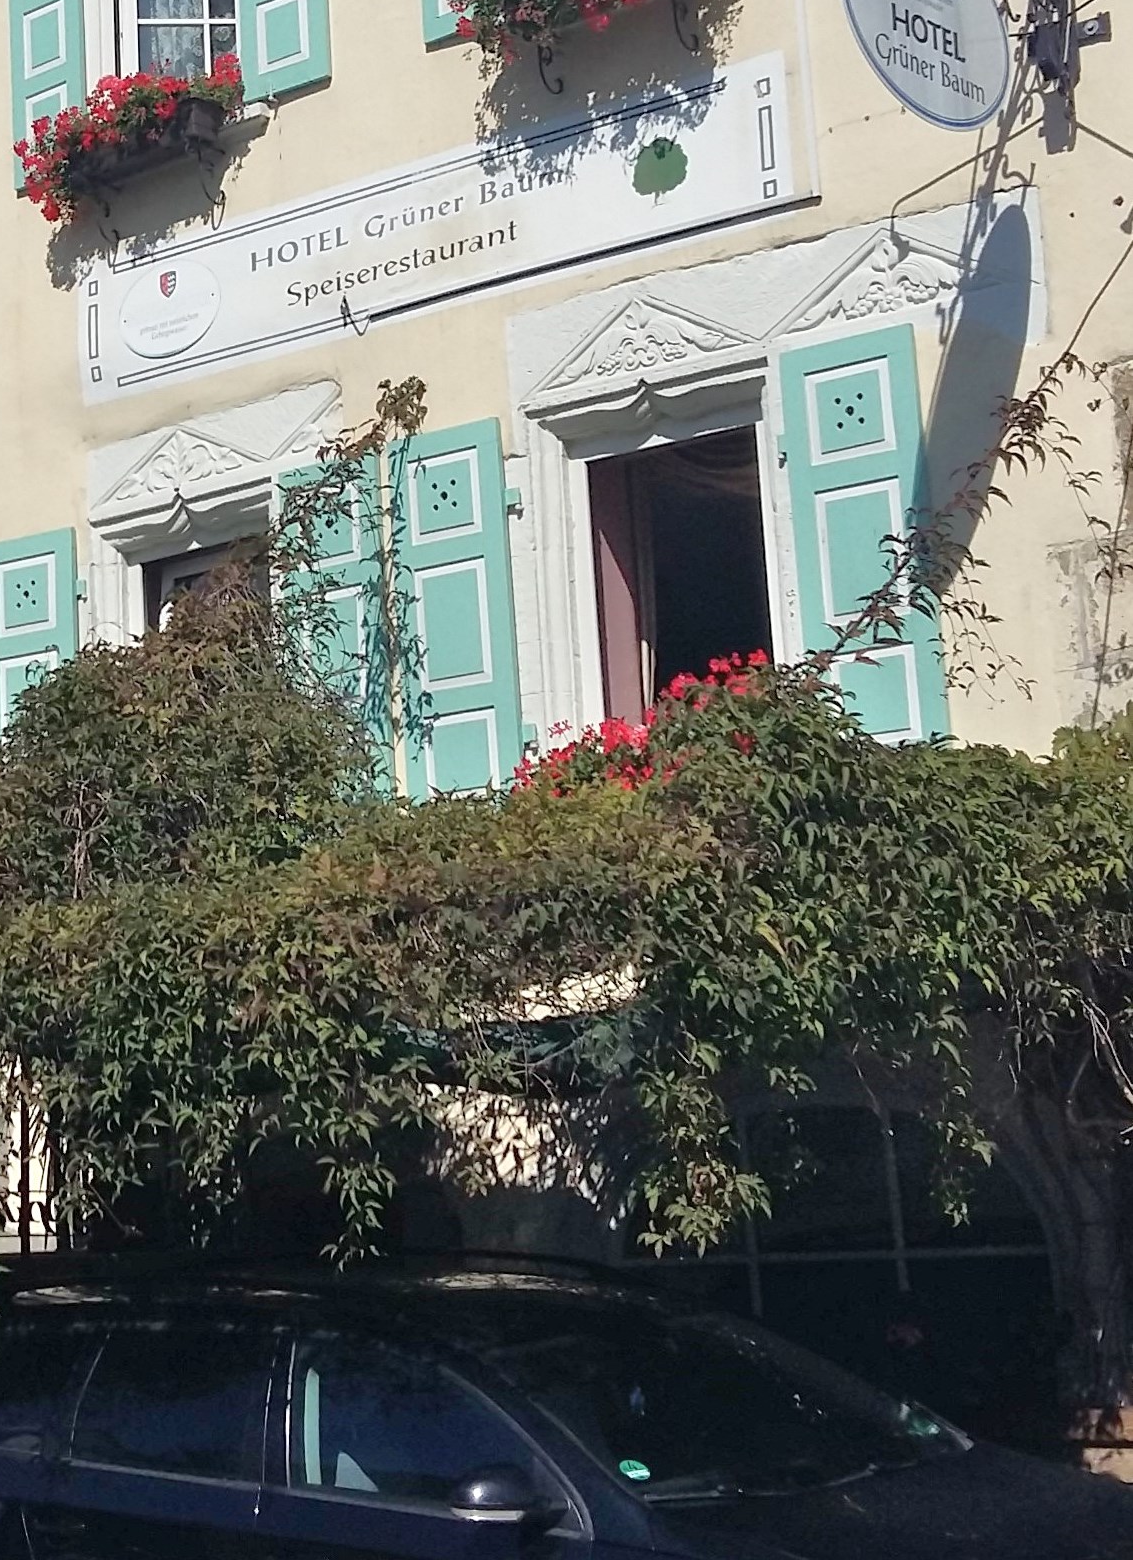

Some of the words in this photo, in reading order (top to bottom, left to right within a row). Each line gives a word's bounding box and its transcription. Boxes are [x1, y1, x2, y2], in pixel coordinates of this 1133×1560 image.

[875, 33, 936, 81] Grüner
[940, 60, 986, 106] Baum
[891, 2, 966, 63] HOTEL
[250, 226, 349, 272] HOTEL
[364, 195, 465, 239] Grüner
[478, 170, 565, 206] Baum
[287, 220, 518, 307] Speiserestaurant
